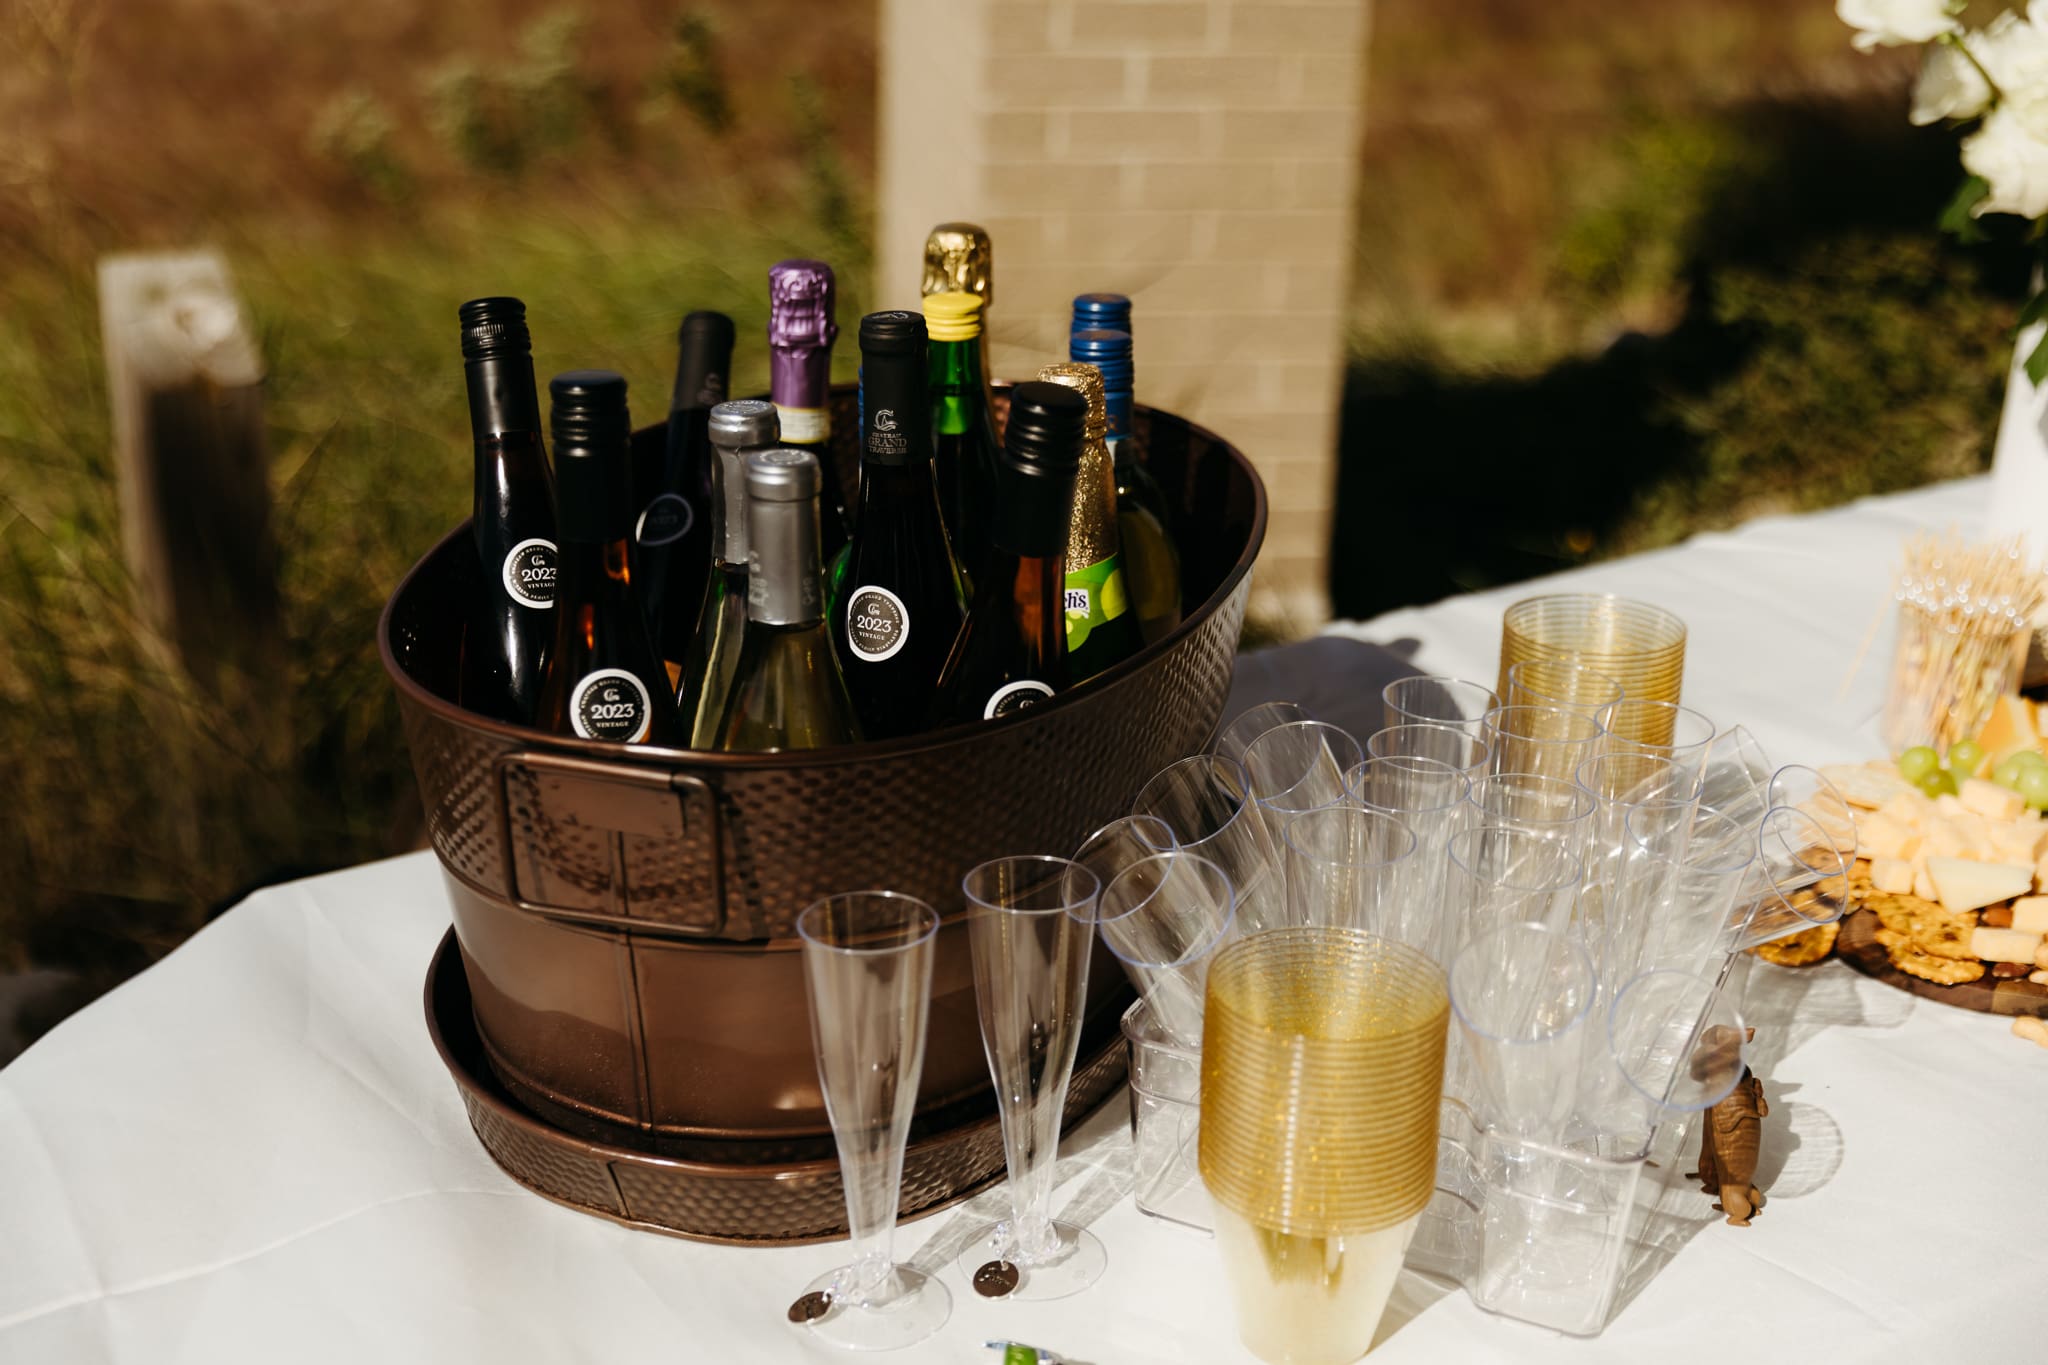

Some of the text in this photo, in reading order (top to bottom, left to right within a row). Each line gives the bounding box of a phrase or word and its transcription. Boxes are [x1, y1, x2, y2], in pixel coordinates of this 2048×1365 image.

[868, 437, 908, 447] GRAND
[1064, 592, 1087, 609] h's
[857, 615, 892, 633] 2023
[859, 631, 885, 641] VINTAGE
[591, 703, 635, 719] 2023
